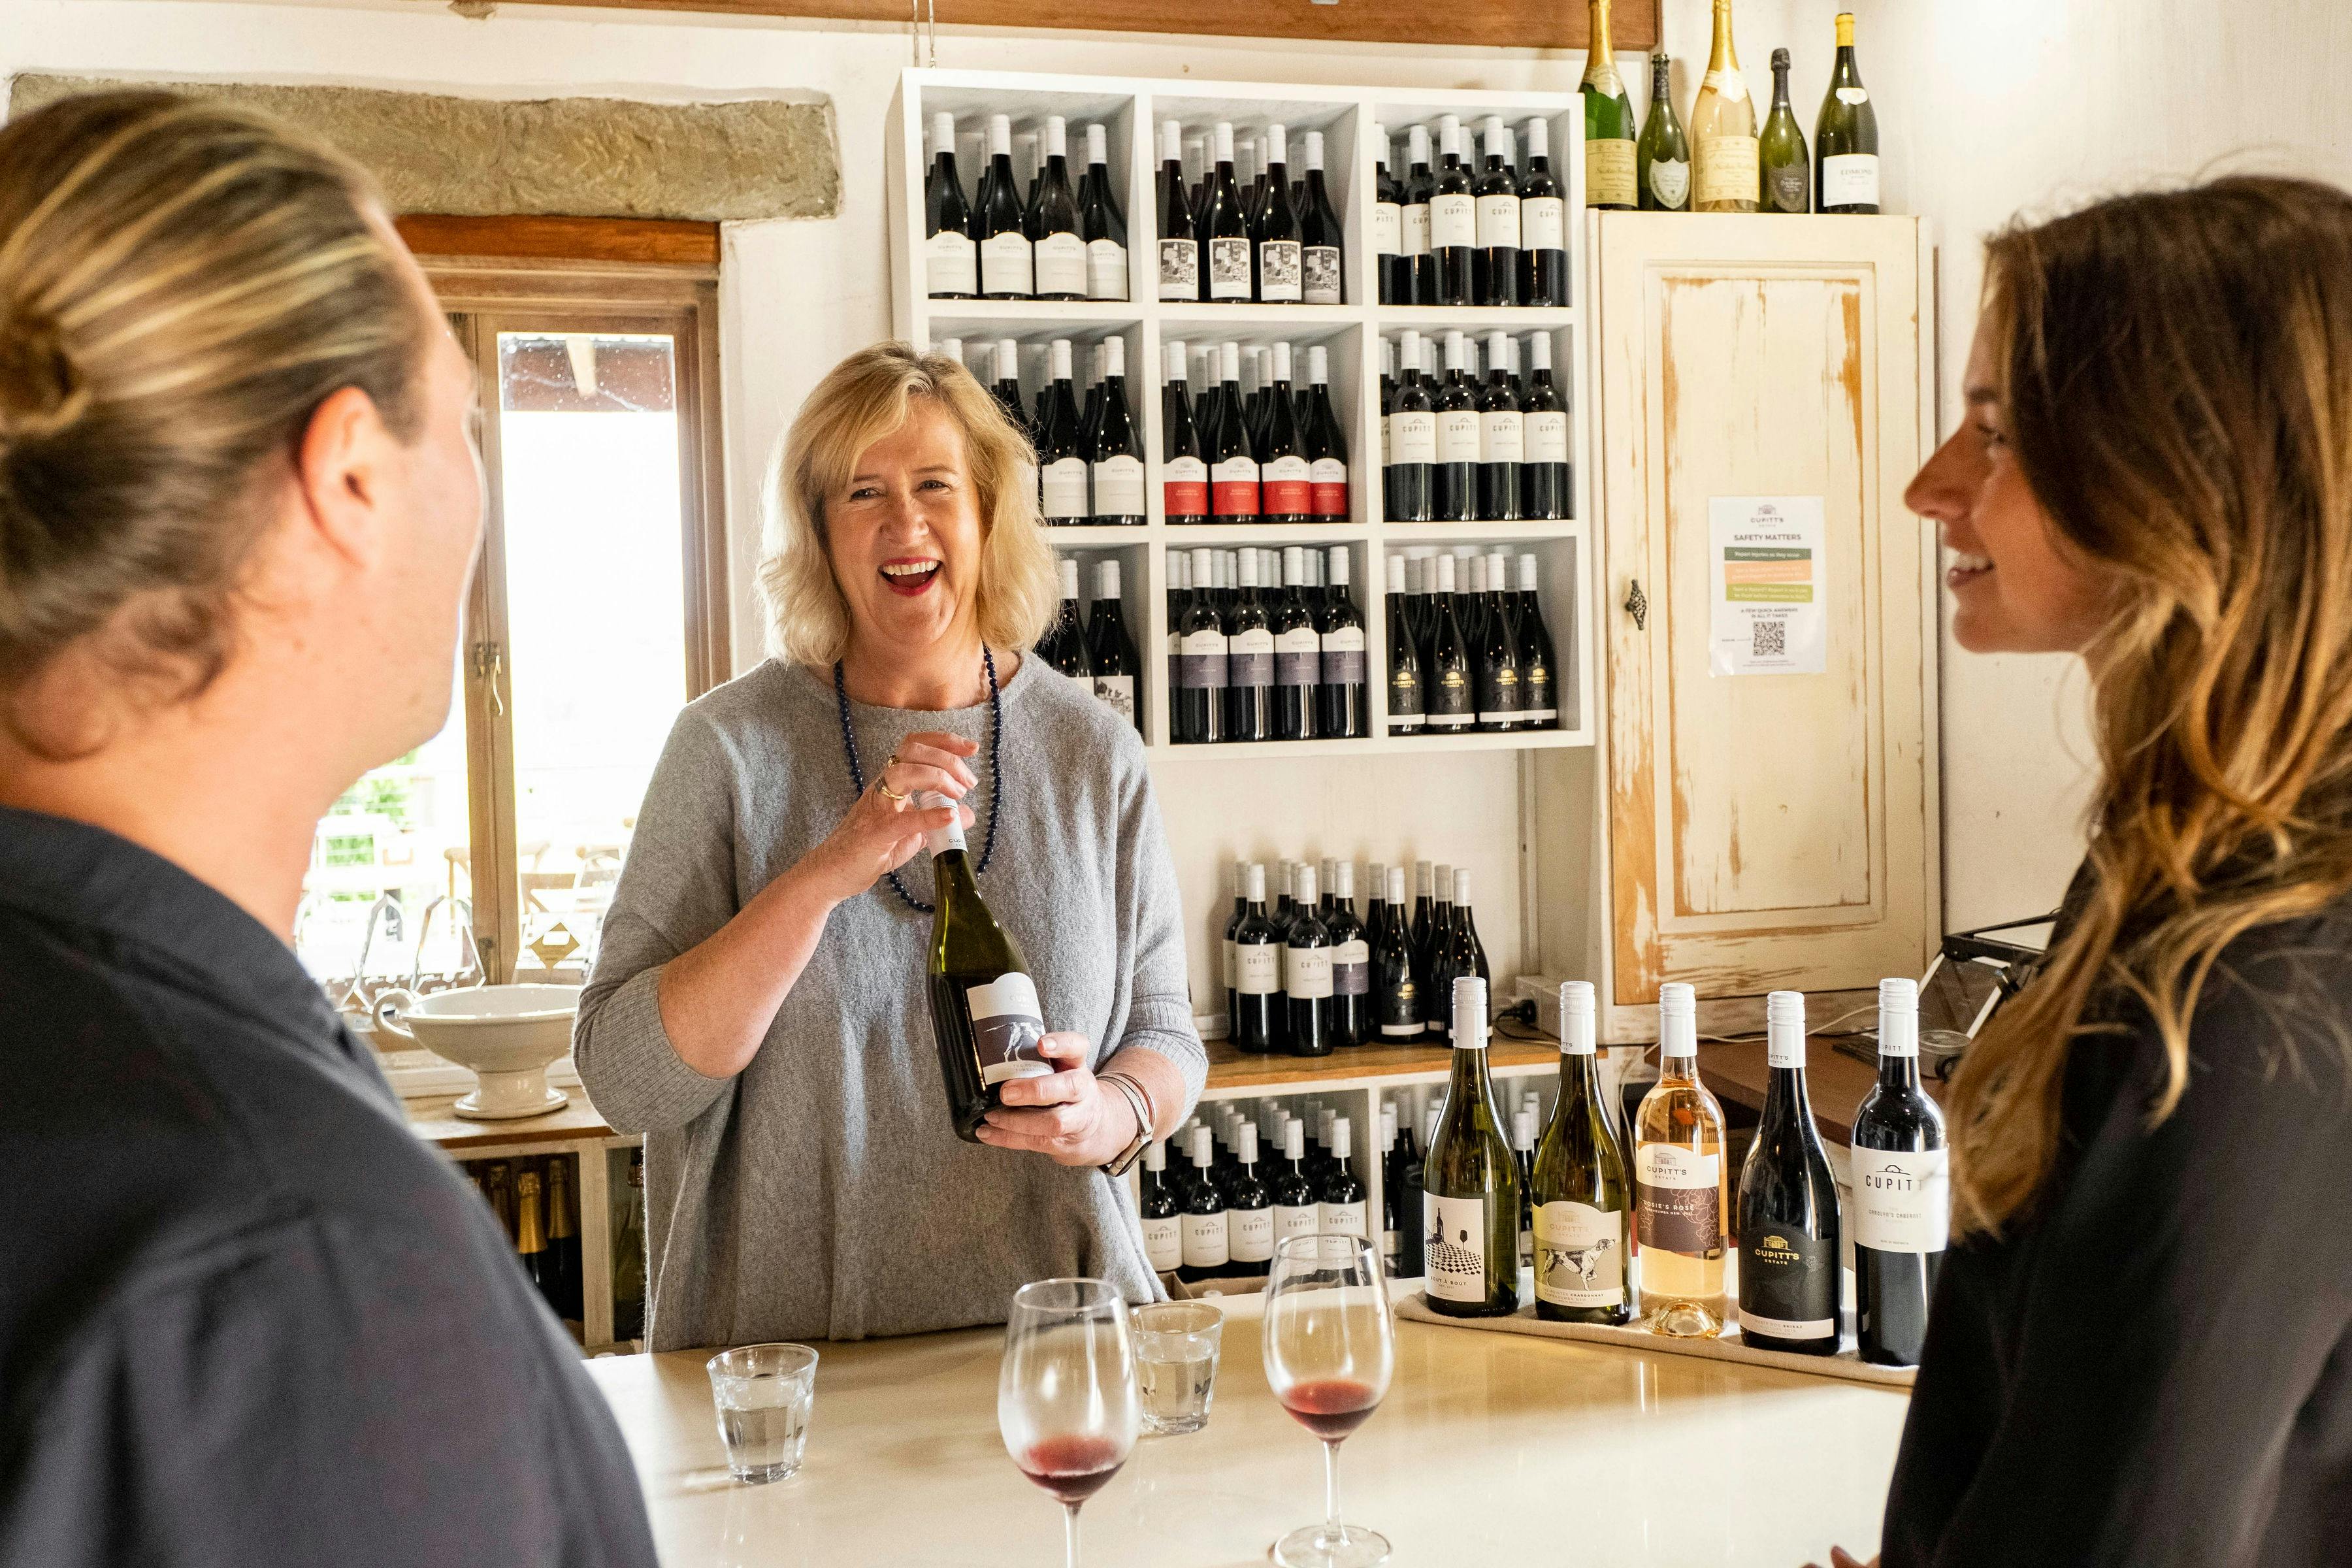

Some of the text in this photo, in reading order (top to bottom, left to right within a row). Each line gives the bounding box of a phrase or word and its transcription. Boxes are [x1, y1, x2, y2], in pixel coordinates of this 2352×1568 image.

[1646, 1166, 1687, 1175] CUPITT'S
[1866, 1175, 1924, 1191] CUPITT
[1643, 1200, 1669, 1210] ROSIE'S
[1755, 1249, 1800, 1260] CUPITT'S
